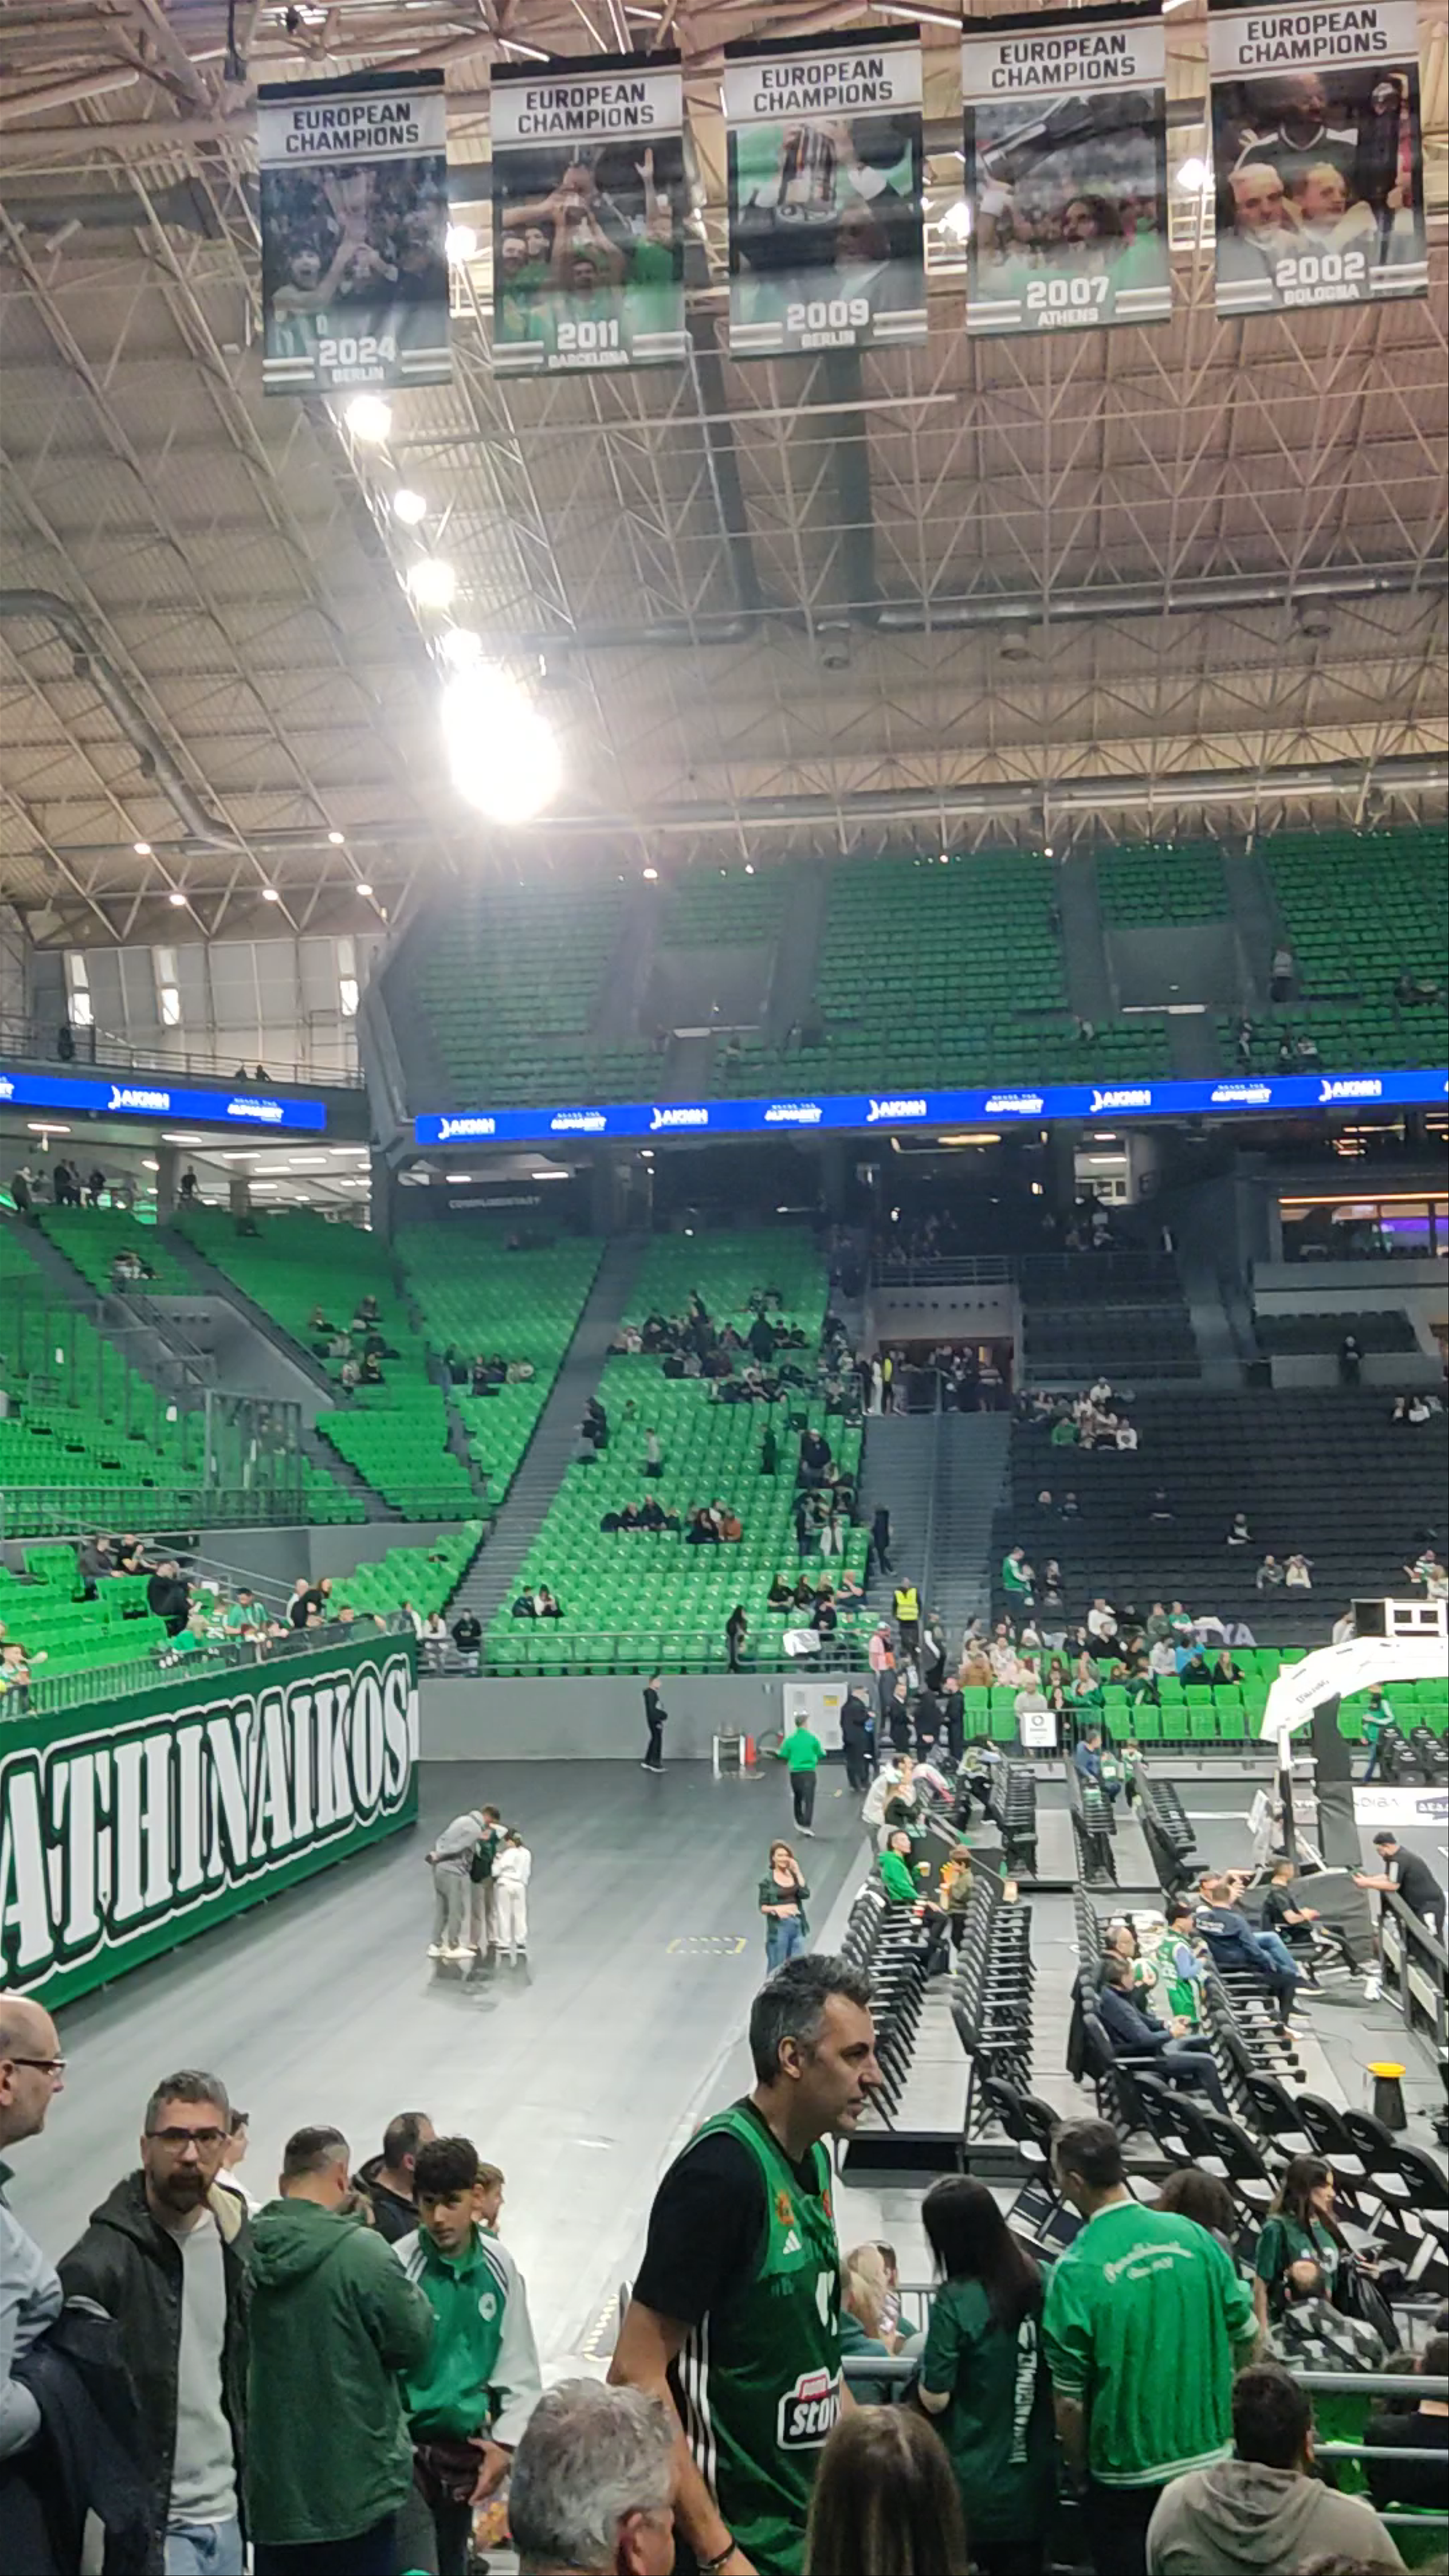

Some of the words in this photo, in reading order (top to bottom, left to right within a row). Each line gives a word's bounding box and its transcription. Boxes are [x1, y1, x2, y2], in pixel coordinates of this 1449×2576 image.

[1247, 9, 1377, 40] EUROPEAN
[1000, 35, 1126, 64] EUROPEAN
[1239, 32, 1387, 65] CHAMPIONS
[762, 59, 883, 88] EUROPEAN
[992, 57, 1135, 88] CHAMPIONS
[526, 83, 645, 110] EUROPEAN
[754, 81, 893, 113] CHAMPIONS
[294, 103, 411, 129] EUROPEAN
[518, 106, 654, 134] CHAMPIONS
[286, 125, 418, 152] CHAMPIONS
[1276, 252, 1365, 287] 2002
[1026, 276, 1109, 309] 2007
[787, 300, 869, 330] 2009
[1038, 308, 1098, 327] ATHENS
[557, 320, 618, 350] 2011
[801, 330, 855, 349] BERLIN
[319, 337, 397, 366] 2024
[548, 349, 630, 368] BARCELONA
[332, 366, 384, 383] BERLIN
